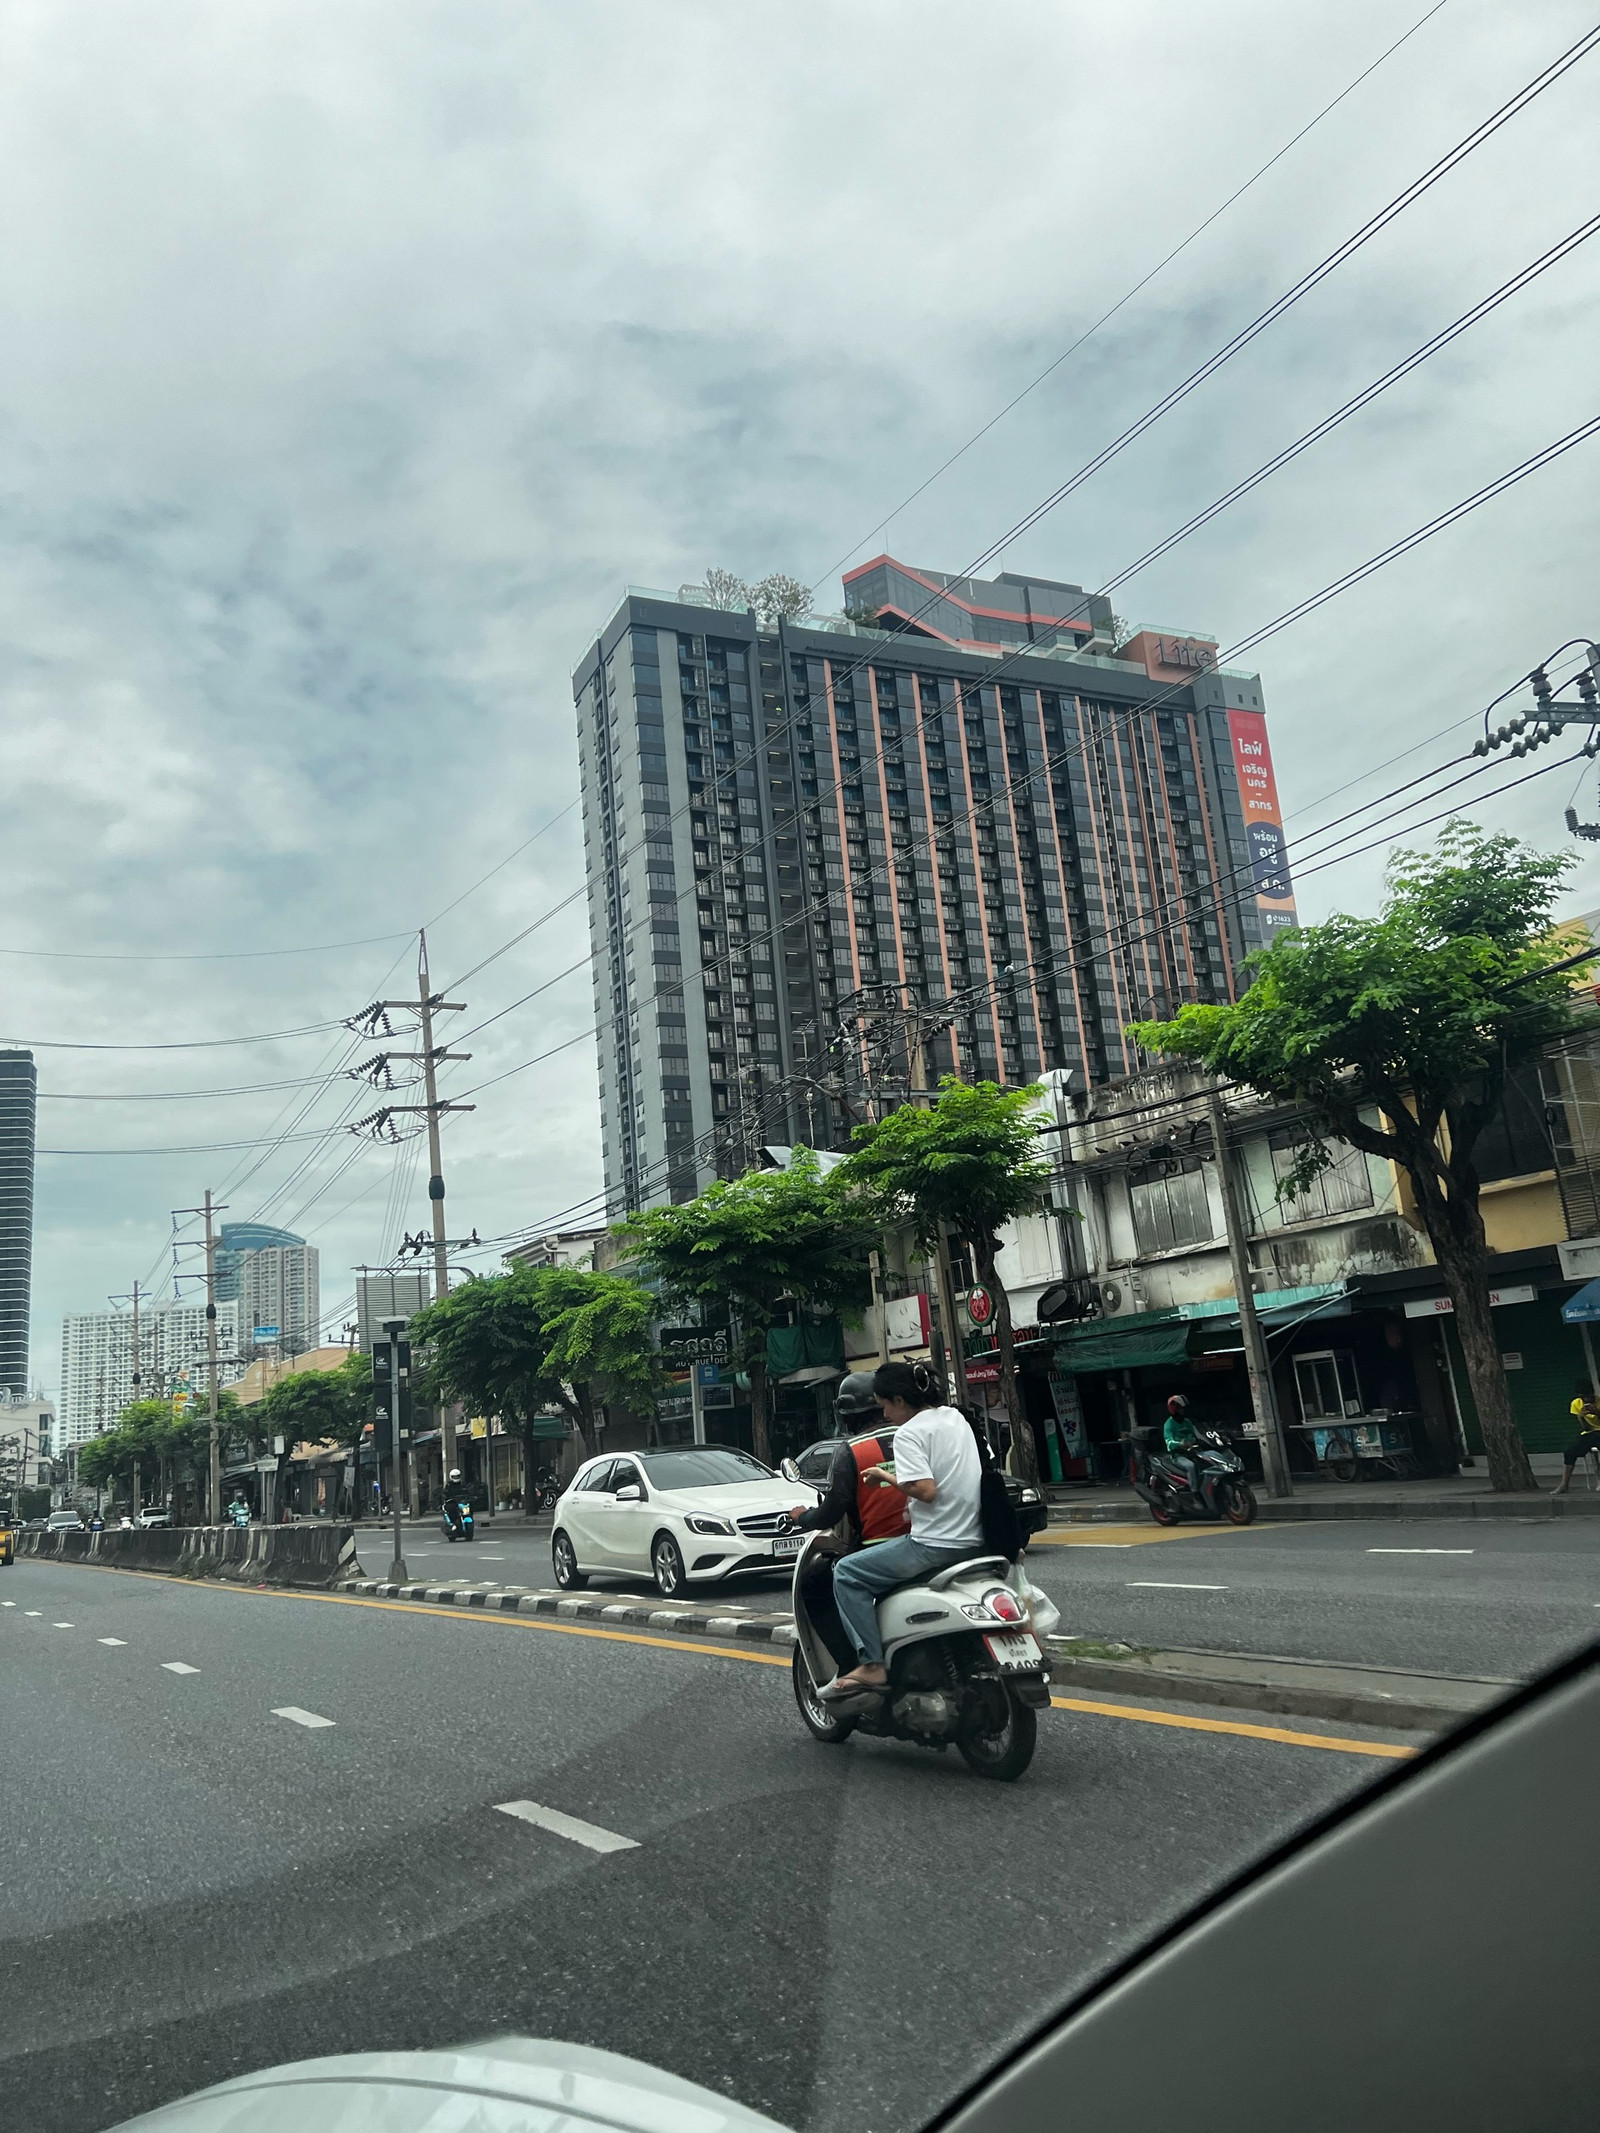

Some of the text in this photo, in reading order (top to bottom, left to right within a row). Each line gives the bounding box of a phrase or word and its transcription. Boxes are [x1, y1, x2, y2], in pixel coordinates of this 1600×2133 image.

[1158, 636, 1214, 667] Life
[1238, 738, 1262, 756] ไลฟ์
[1242, 763, 1267, 778] เจริญ
[1247, 778, 1267, 789] นคร
[1248, 800, 1273, 811] สาทร
[1253, 830, 1278, 842] พร้อม
